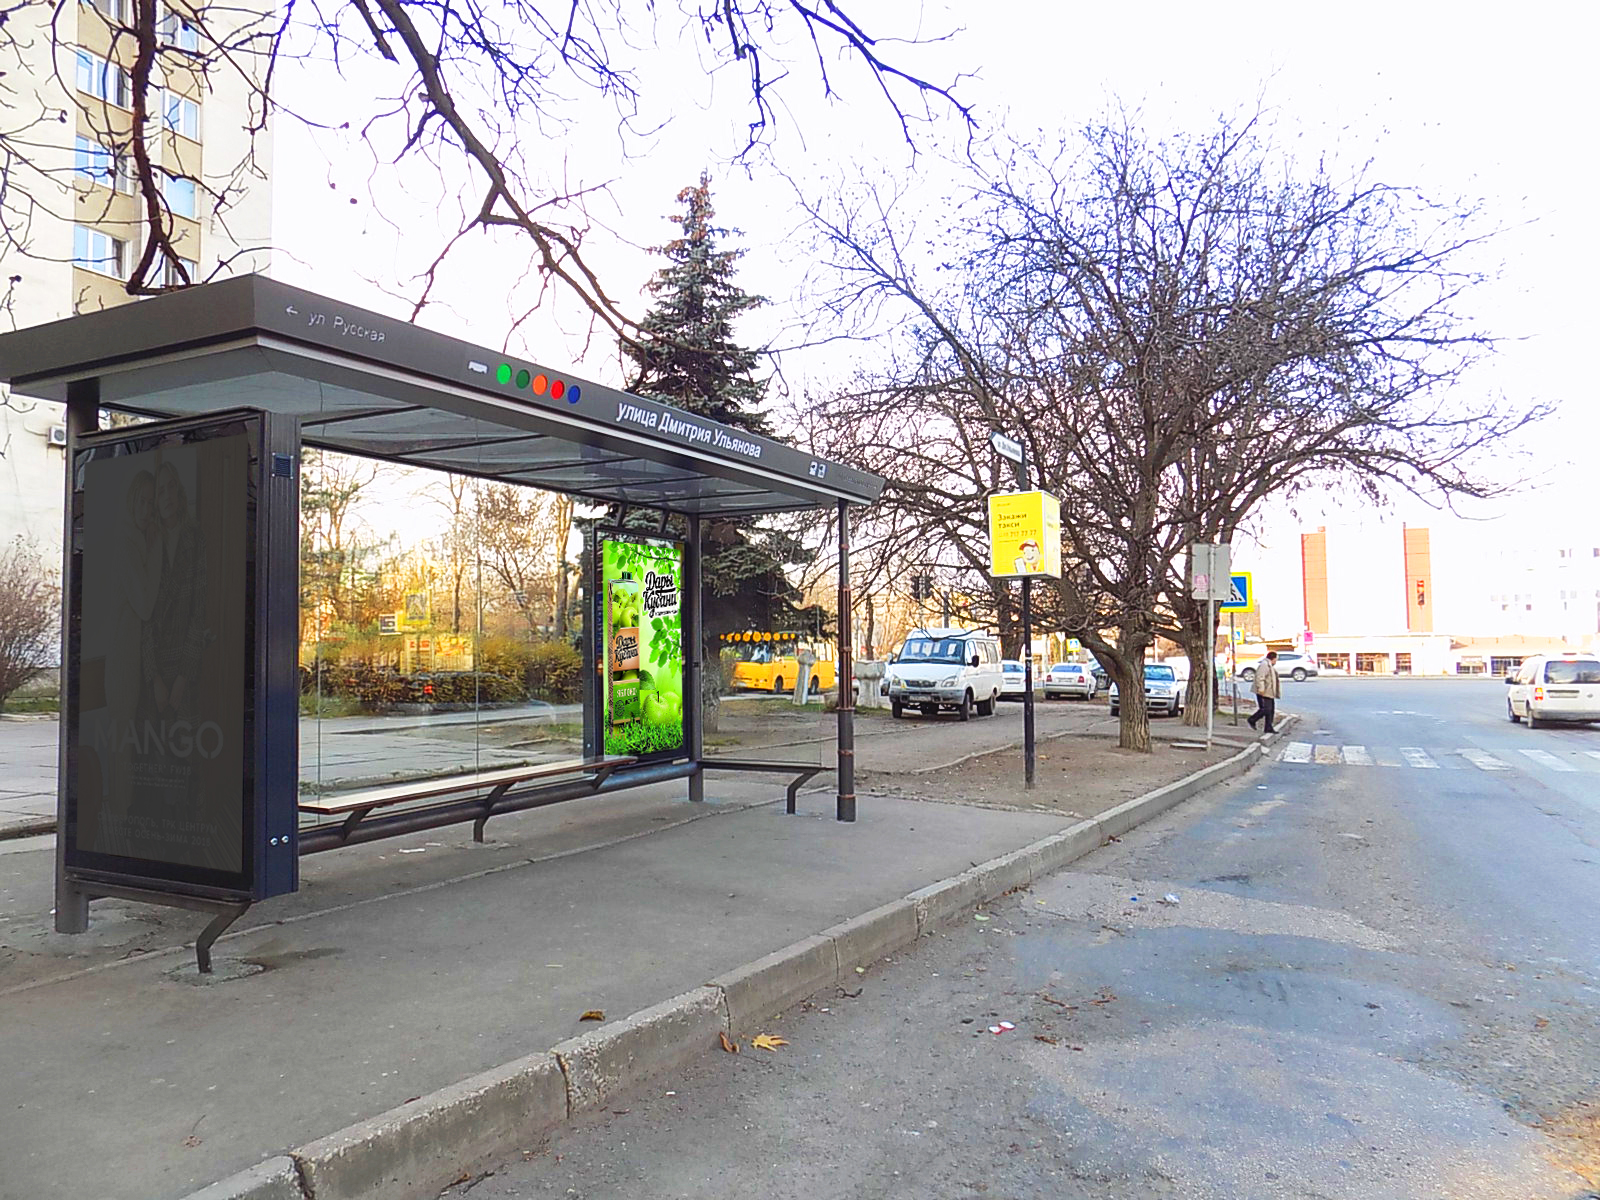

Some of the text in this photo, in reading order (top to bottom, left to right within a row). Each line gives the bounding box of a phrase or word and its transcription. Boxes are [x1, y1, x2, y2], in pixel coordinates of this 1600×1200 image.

[308, 311, 386, 344] ул Русская
[615, 402, 762, 459] улица Дмитрия Ульянова
[645, 571, 676, 593] Дары
[643, 590, 677, 618] Кубани
[94, 718, 224, 760] MANGO
